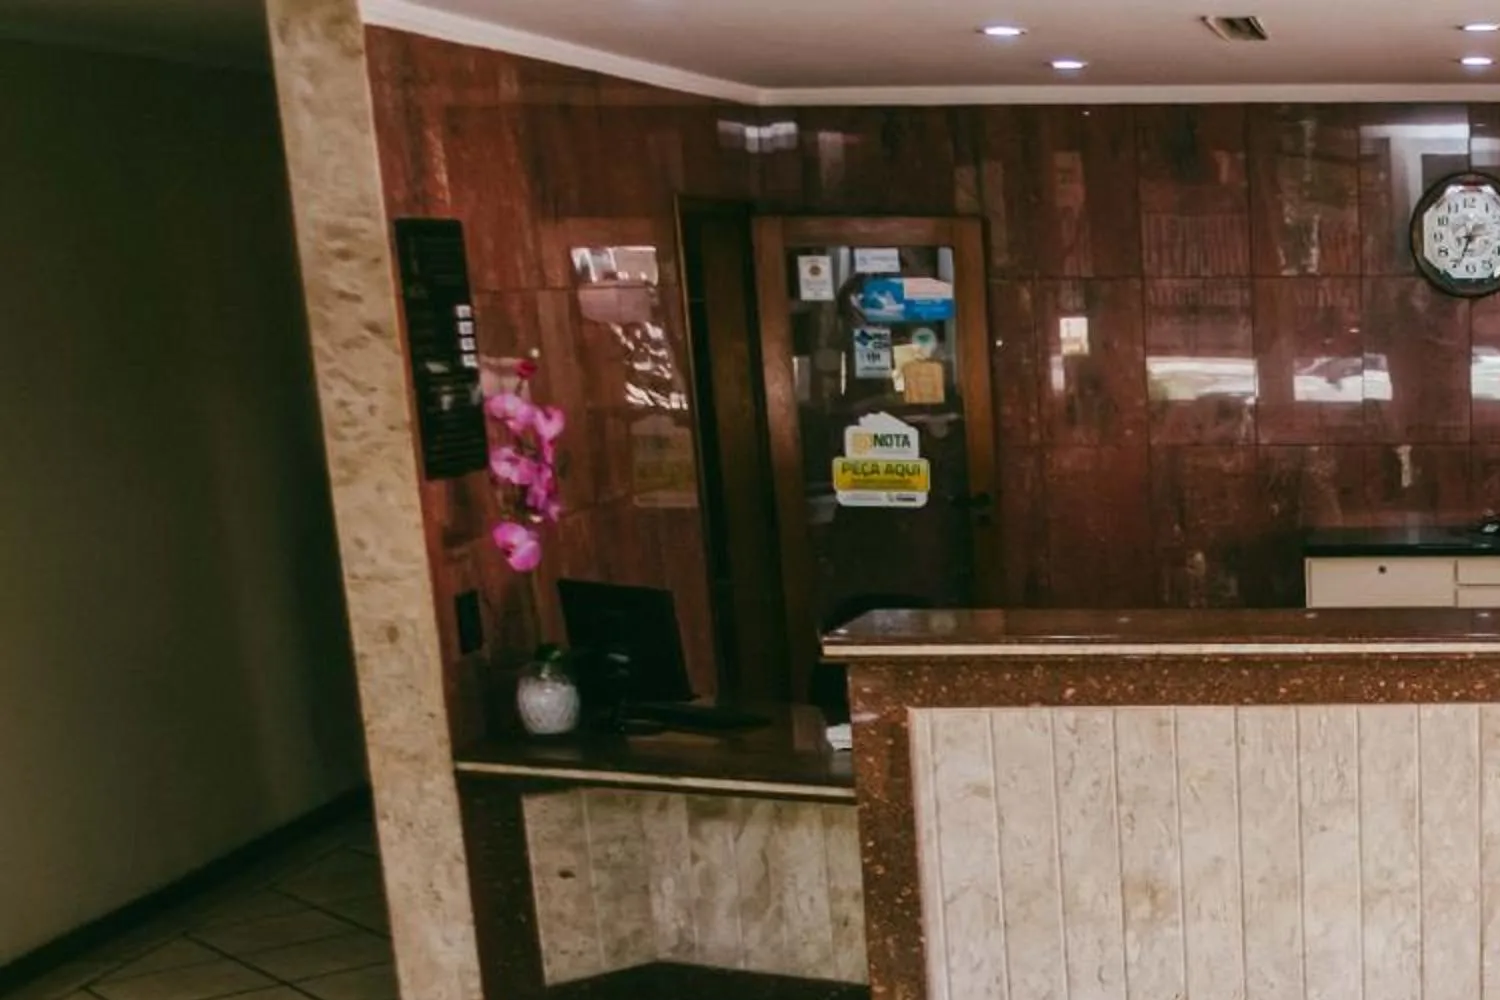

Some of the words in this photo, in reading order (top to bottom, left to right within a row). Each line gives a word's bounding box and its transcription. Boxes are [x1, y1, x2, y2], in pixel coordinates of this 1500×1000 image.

[1447, 202, 1459, 213] 11
[1463, 198, 1476, 208] 12
[1437, 216, 1449, 226] 10
[1438, 247, 1449, 257] 8
[1465, 264, 1477, 274] 6
[873, 432, 911, 448] NOTA
[841, 461, 880, 477] PEÇA
[884, 463, 921, 477] AQUI
